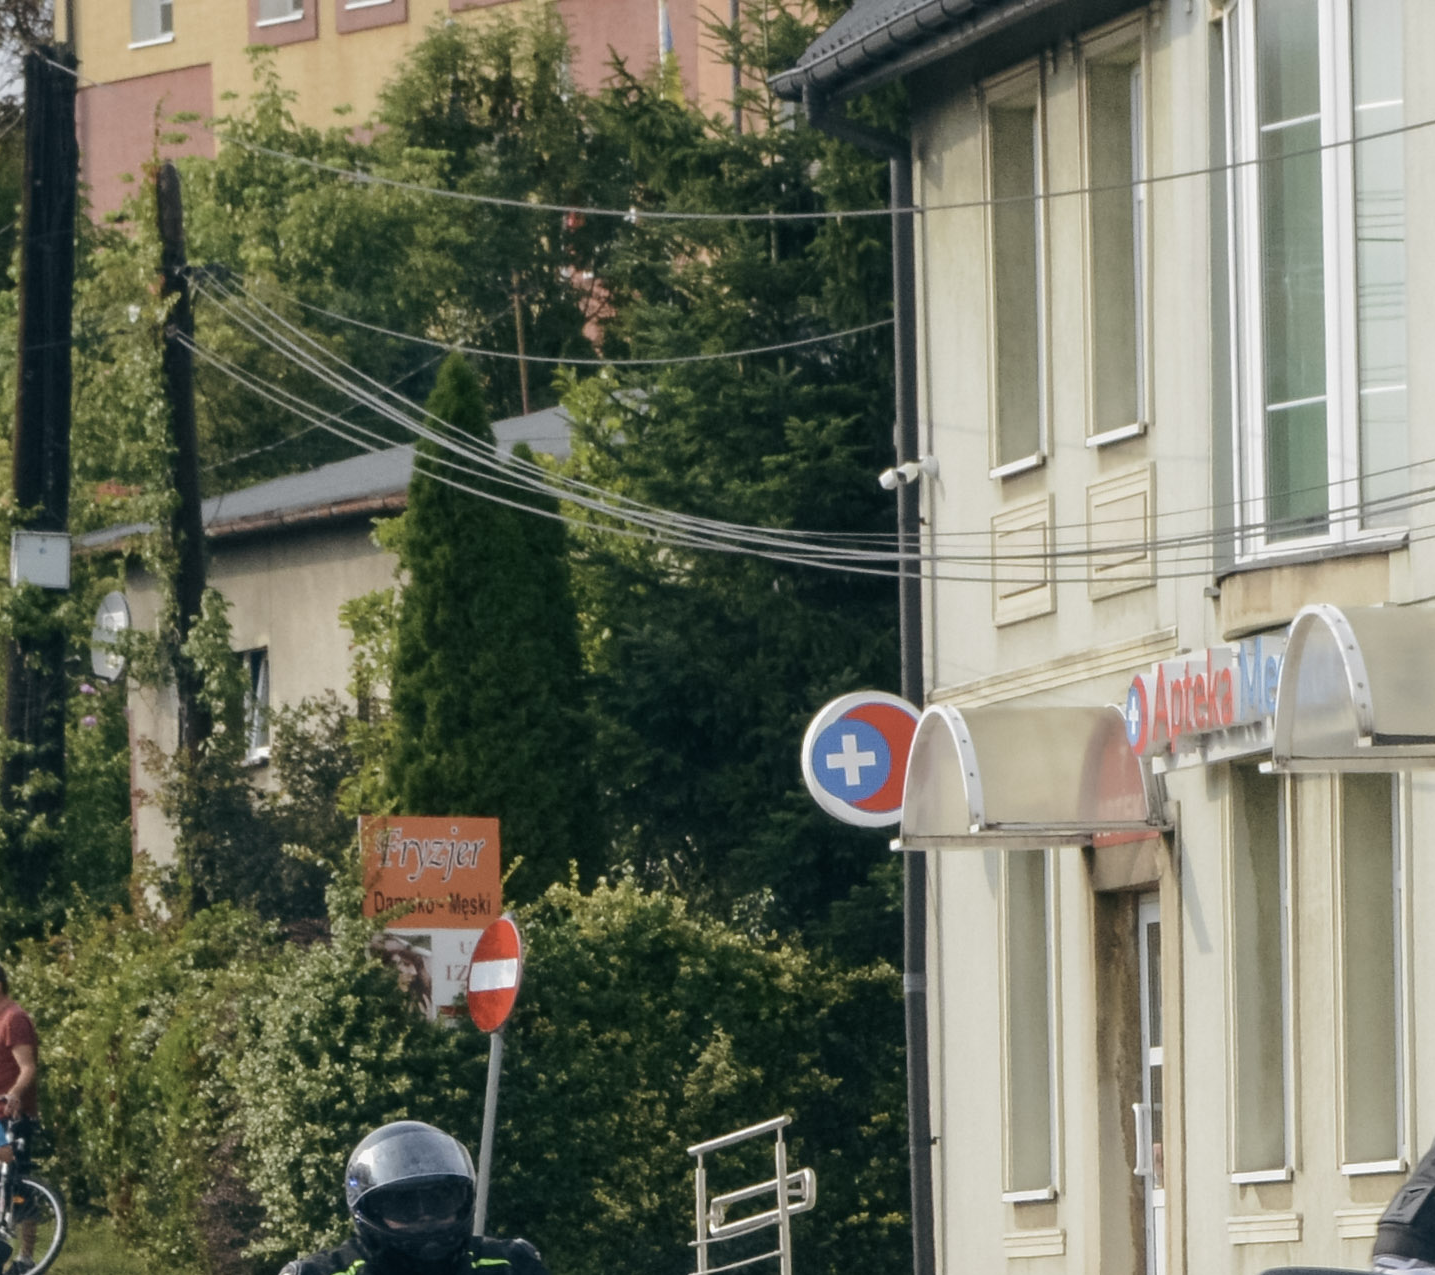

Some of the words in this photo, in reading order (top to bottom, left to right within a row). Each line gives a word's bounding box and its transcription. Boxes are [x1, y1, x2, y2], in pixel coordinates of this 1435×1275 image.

[1152, 647, 1235, 753] Apteka
[375, 826, 486, 882] Fryzjer
[449, 892, 491, 920] Męski
